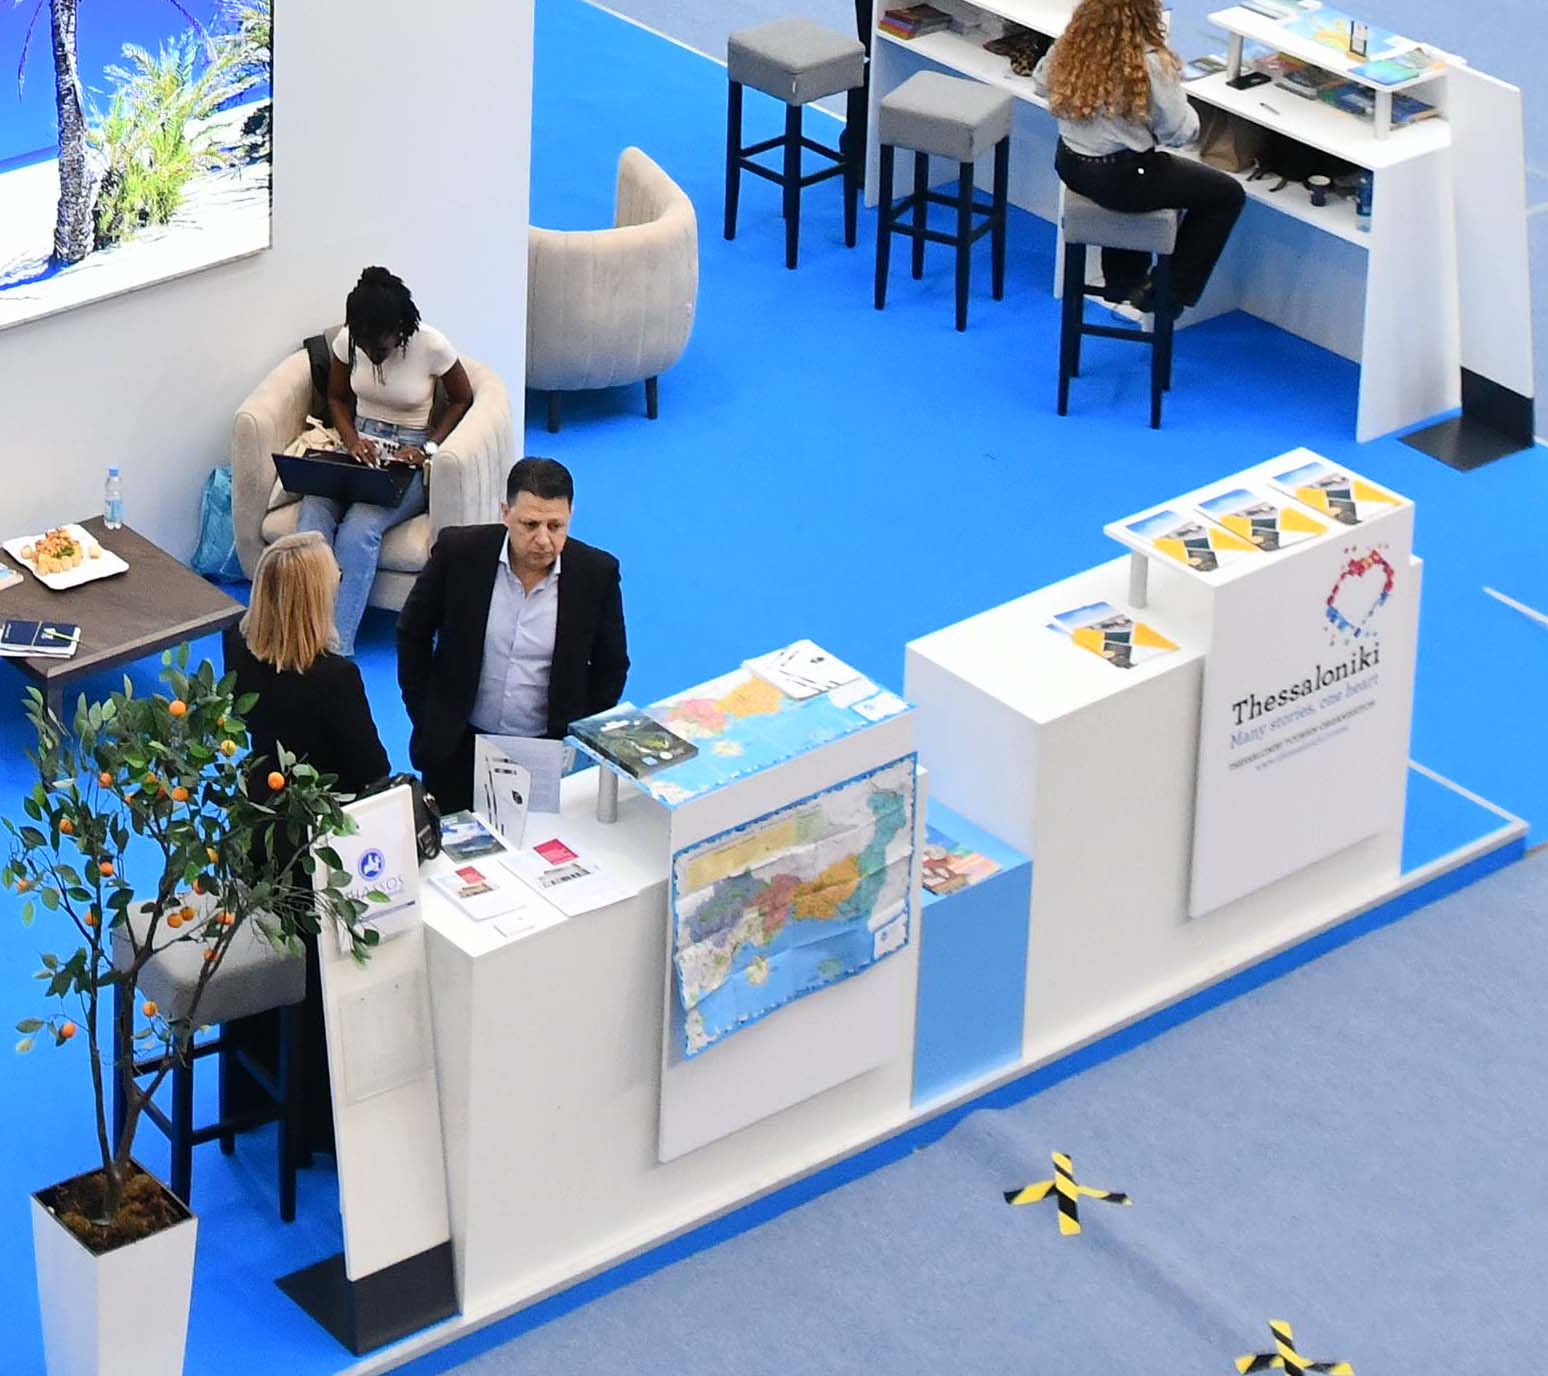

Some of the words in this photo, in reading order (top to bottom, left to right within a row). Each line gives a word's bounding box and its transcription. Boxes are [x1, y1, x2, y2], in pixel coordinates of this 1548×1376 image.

[1230, 724, 1266, 749] Many
[1269, 702, 1317, 732] stories,
[1319, 690, 1342, 709] one
[1345, 673, 1379, 699] heart
[1231, 641, 1380, 727] Thessaloniki
